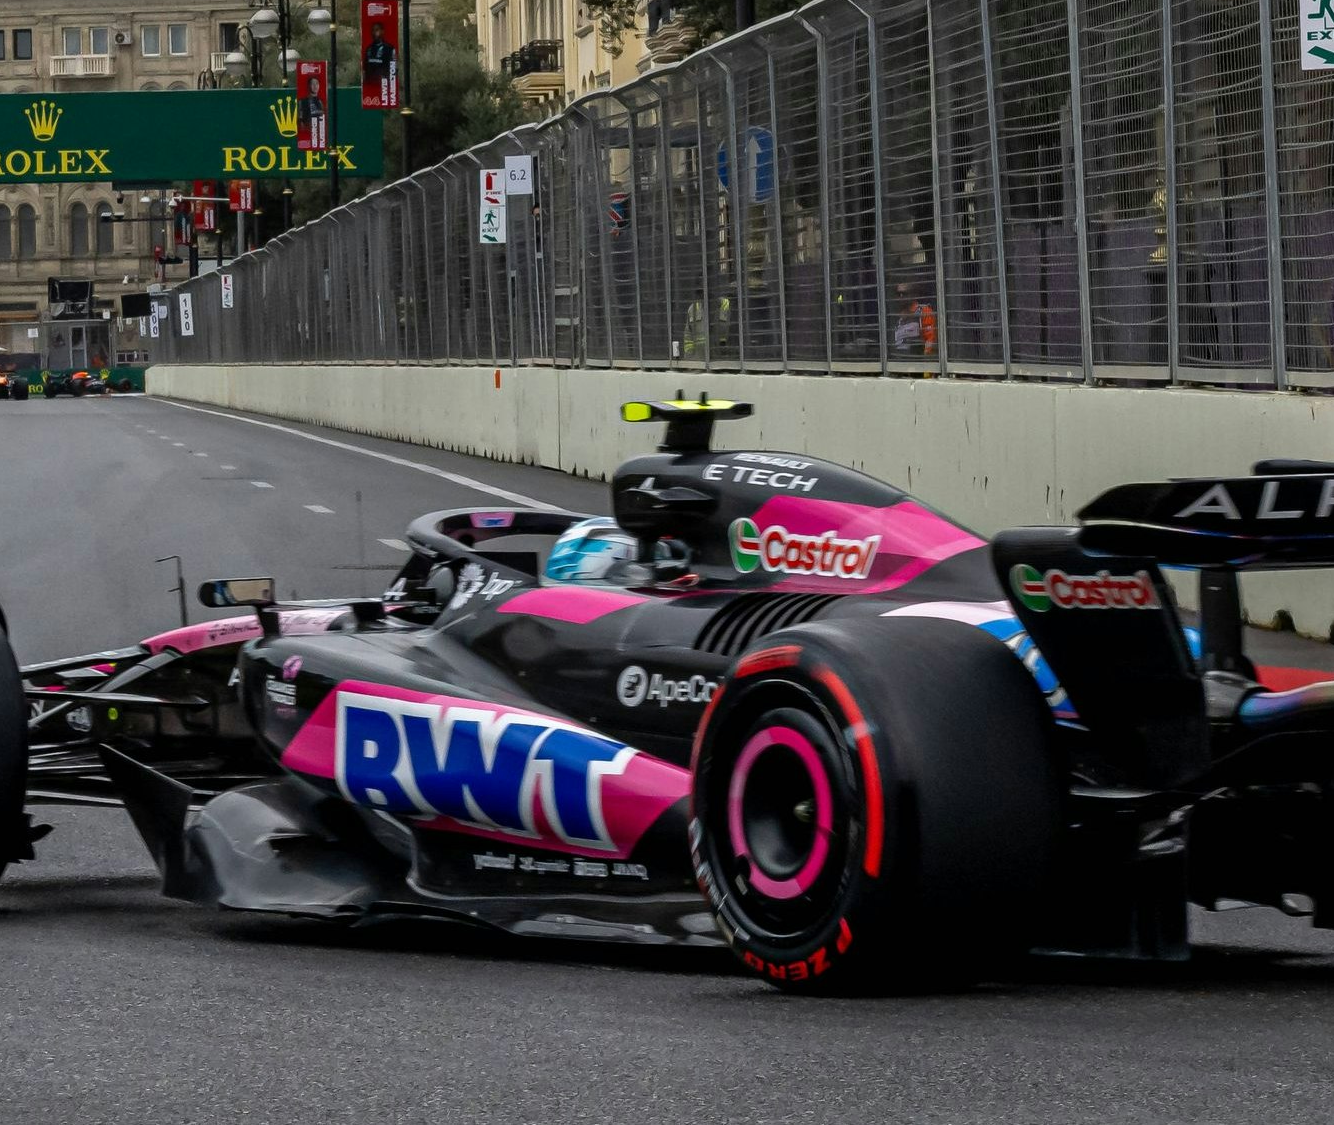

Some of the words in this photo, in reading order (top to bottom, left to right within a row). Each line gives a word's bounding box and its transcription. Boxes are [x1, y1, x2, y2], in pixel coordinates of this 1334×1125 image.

[222, 145, 357, 172] ROLEX
[509, 169, 526, 181] 6.2
[150, 304, 158, 335] 100
[703, 463, 730, 481] E
[732, 465, 819, 492] TECH
[733, 453, 815, 471] RENAULT
[763, 527, 880, 578] Castrol
[480, 572, 515, 601] bp
[1046, 570, 1160, 608] Castrol
[646, 673, 721, 708] ApeCo
[338, 695, 638, 850] BWT
[743, 947, 832, 981] ZERO
